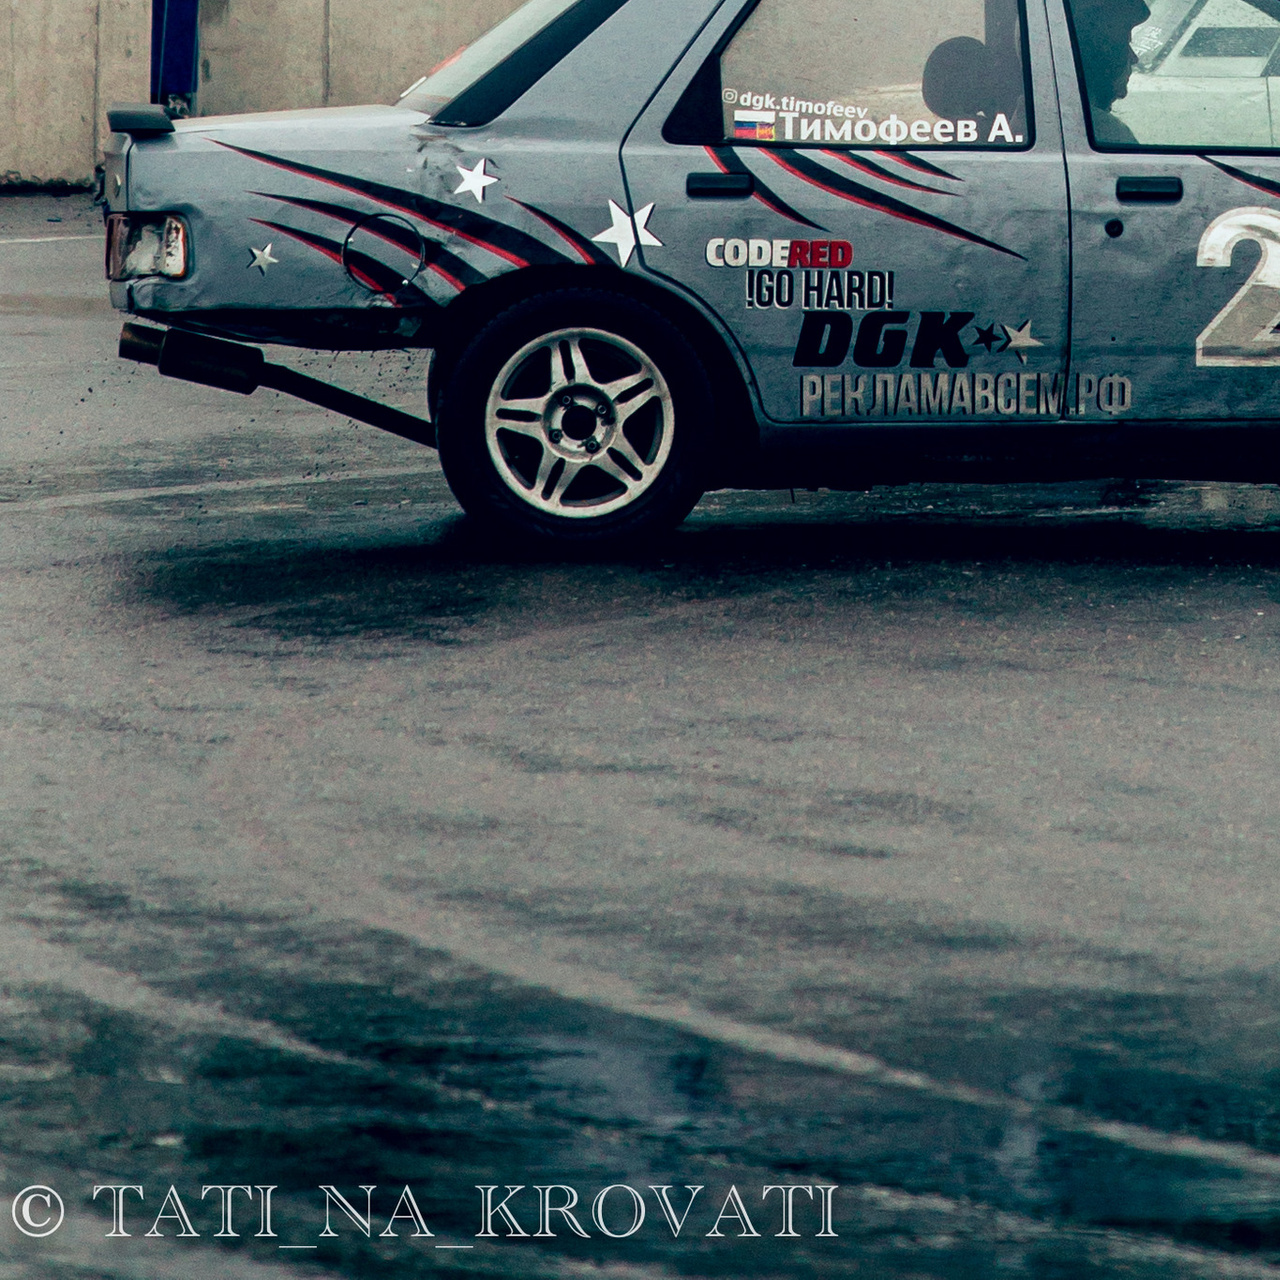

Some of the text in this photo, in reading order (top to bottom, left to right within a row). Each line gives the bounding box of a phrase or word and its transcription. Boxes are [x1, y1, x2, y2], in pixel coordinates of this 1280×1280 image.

[739, 91, 869, 119] dgk.timofeev
[778, 111, 1024, 145] Тимофеев А.
[745, 269, 895, 310] !GO HARD!
[792, 310, 976, 369] DGK
[799, 372, 1132, 417] РЕКЛАМАВСЕМ.РФ
